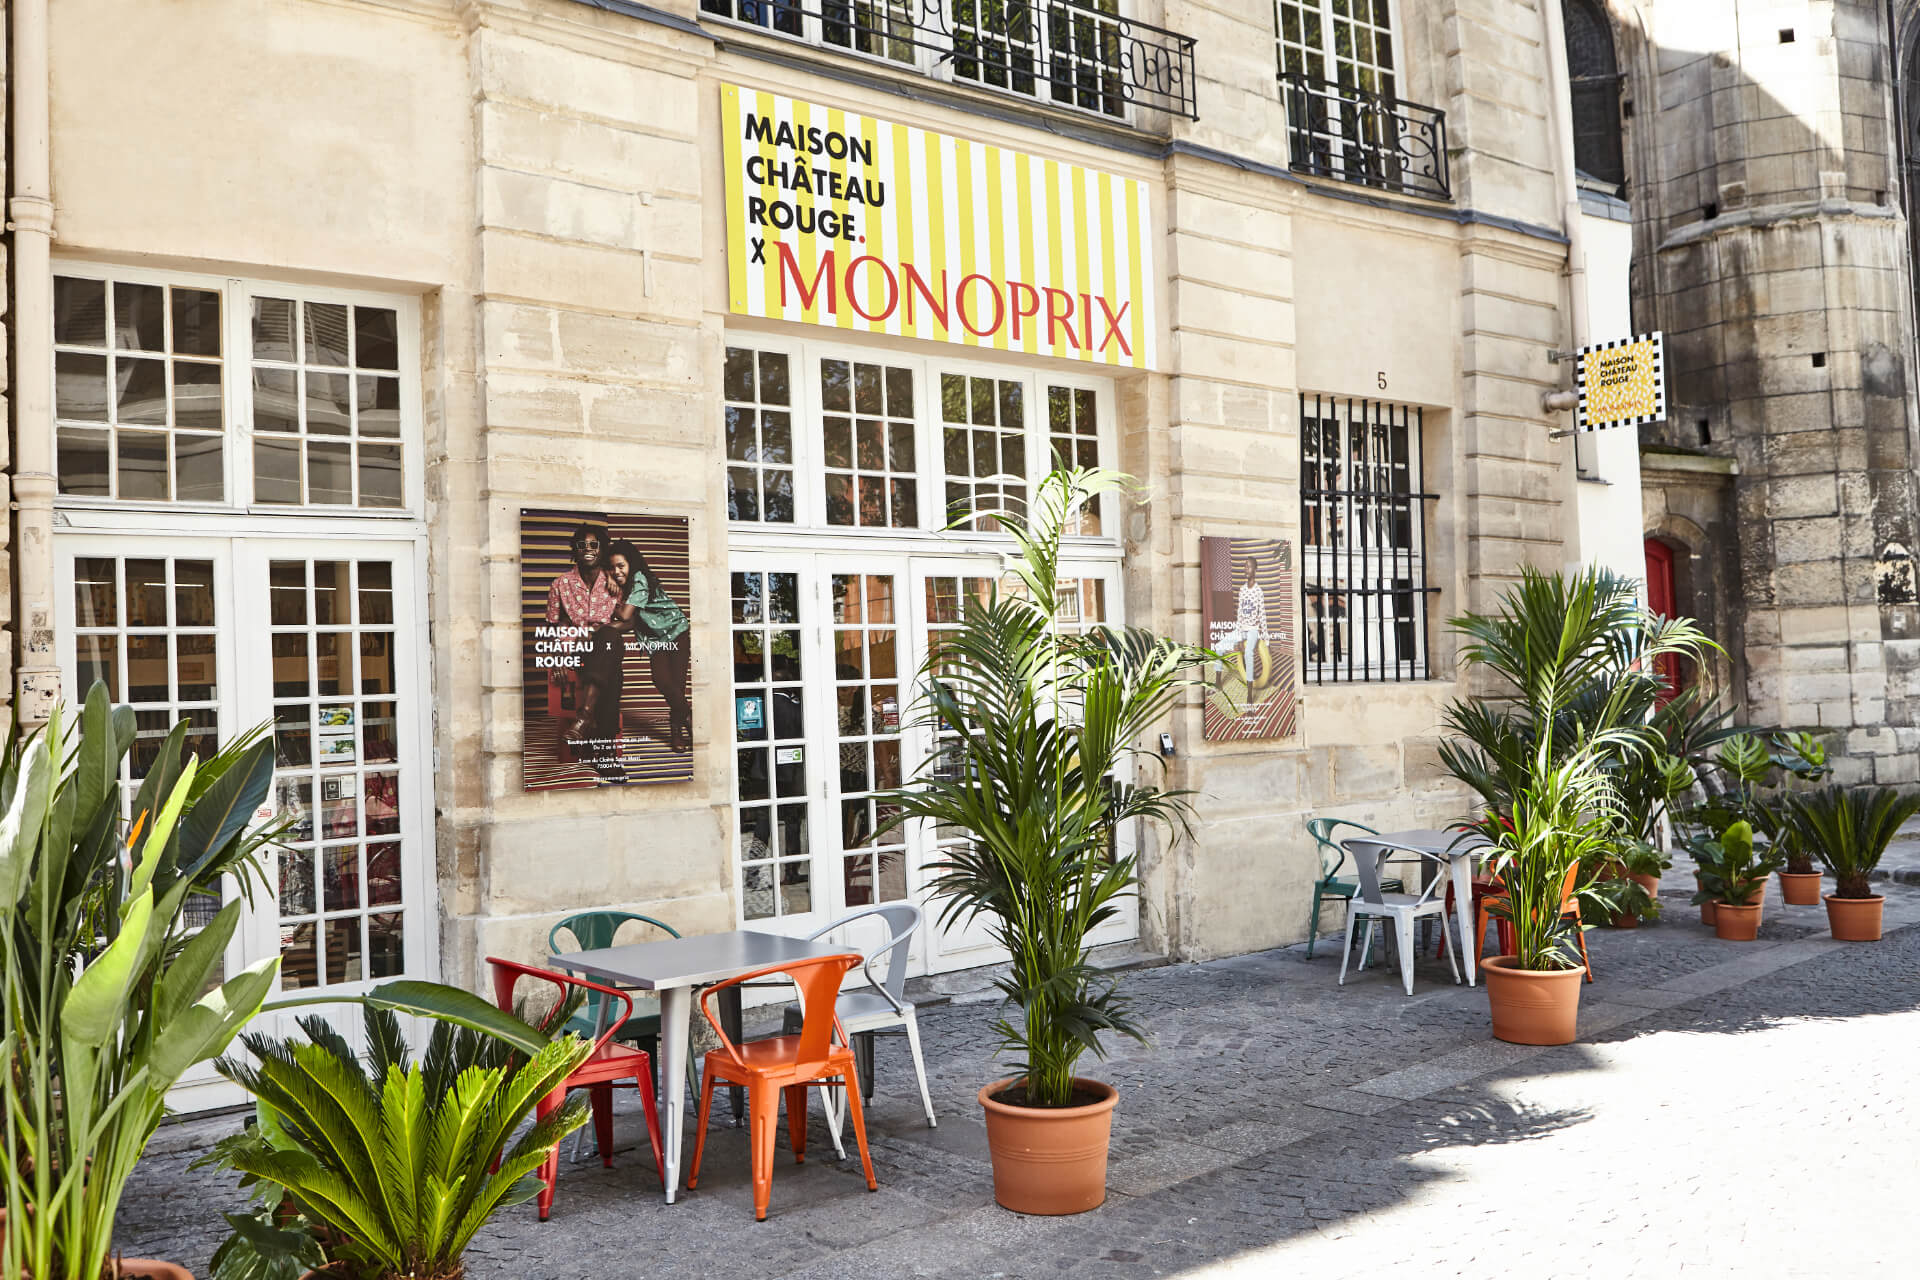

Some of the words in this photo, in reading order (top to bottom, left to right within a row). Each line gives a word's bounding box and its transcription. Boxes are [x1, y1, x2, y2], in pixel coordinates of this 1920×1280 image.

[744, 112, 873, 167] MAISON
[745, 155, 885, 208] CHÂTEAU
[773, 240, 1133, 357] MONOPRIX
[1600, 355, 1634, 368] MAISON
[1378, 371, 1387, 390] 5
[535, 626, 589, 638] MAISON
[535, 639, 594, 653] CHÂTEAU
[624, 641, 679, 651] MONOPRIX
